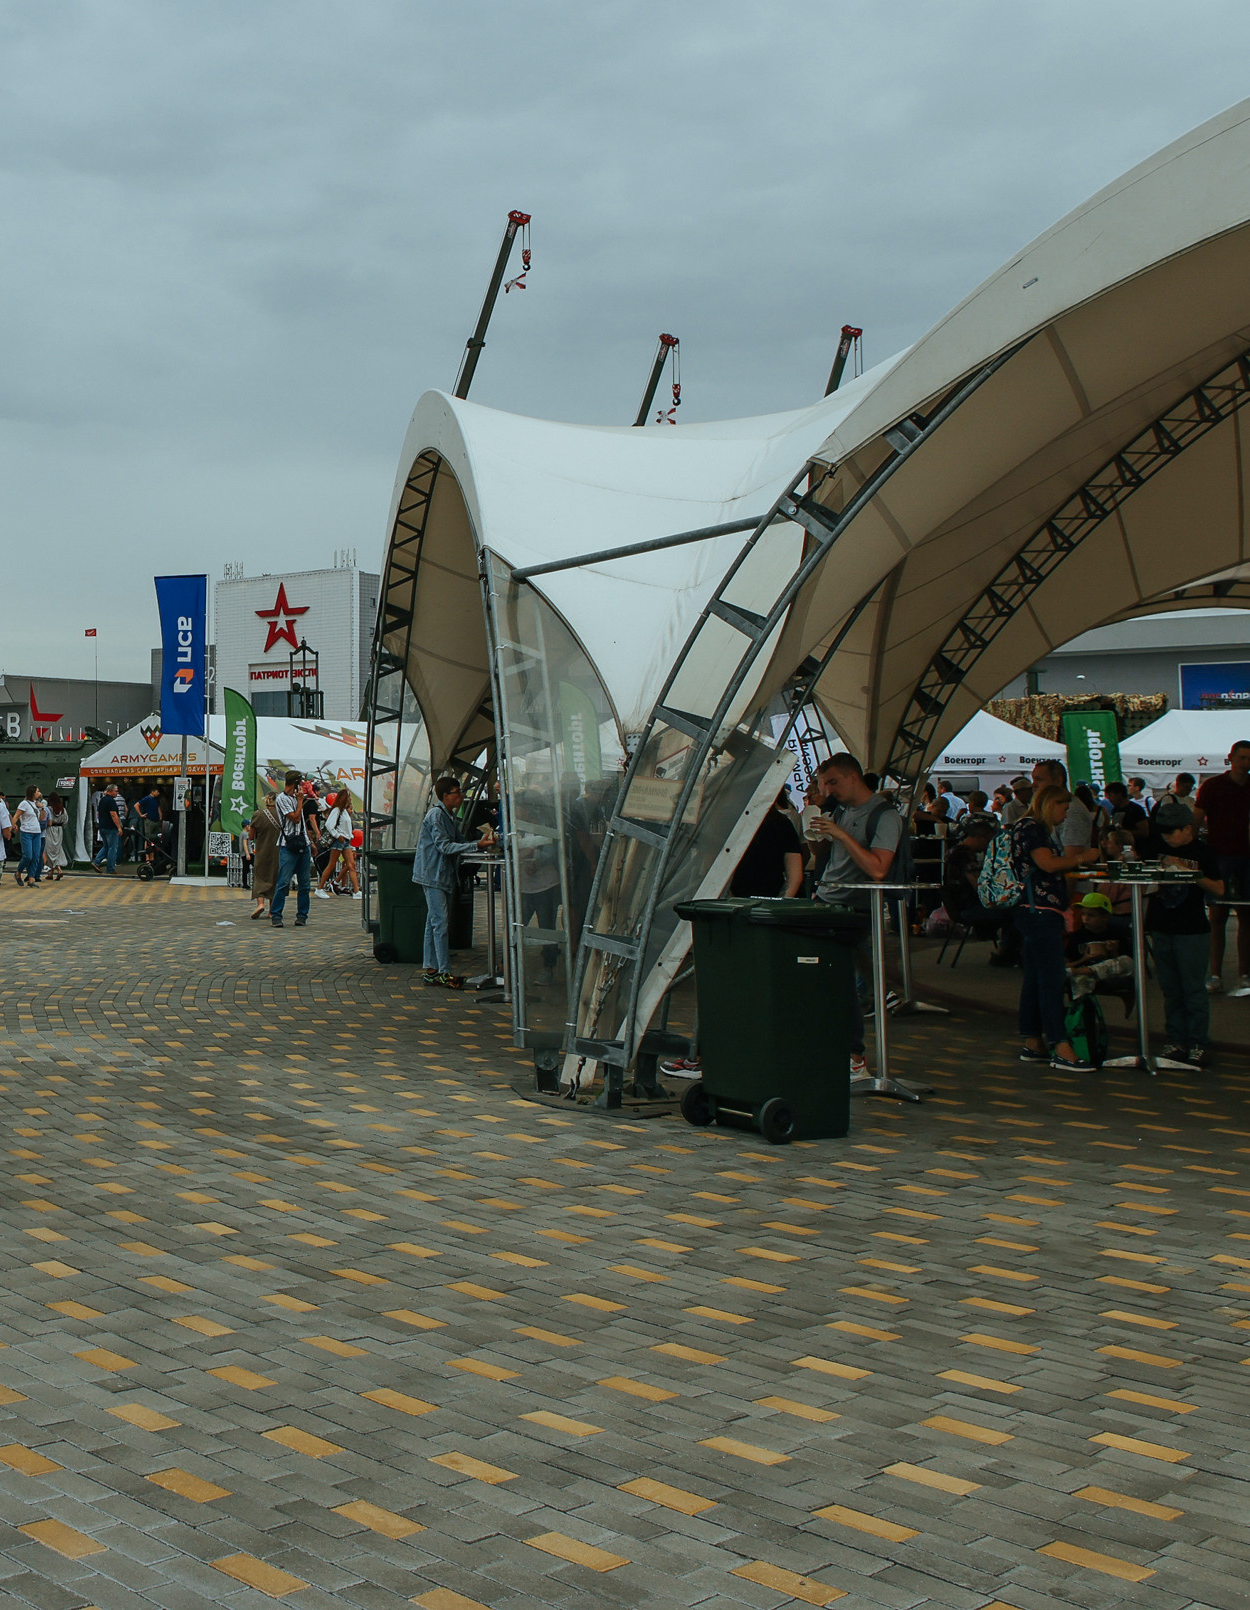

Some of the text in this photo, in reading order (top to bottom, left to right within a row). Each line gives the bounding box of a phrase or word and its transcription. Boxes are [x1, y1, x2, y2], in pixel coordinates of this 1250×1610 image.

[250, 670, 289, 681] ПАТРИОТ
[944, 756, 986, 765] Военторг
[1137, 758, 1182, 767] Военторг
